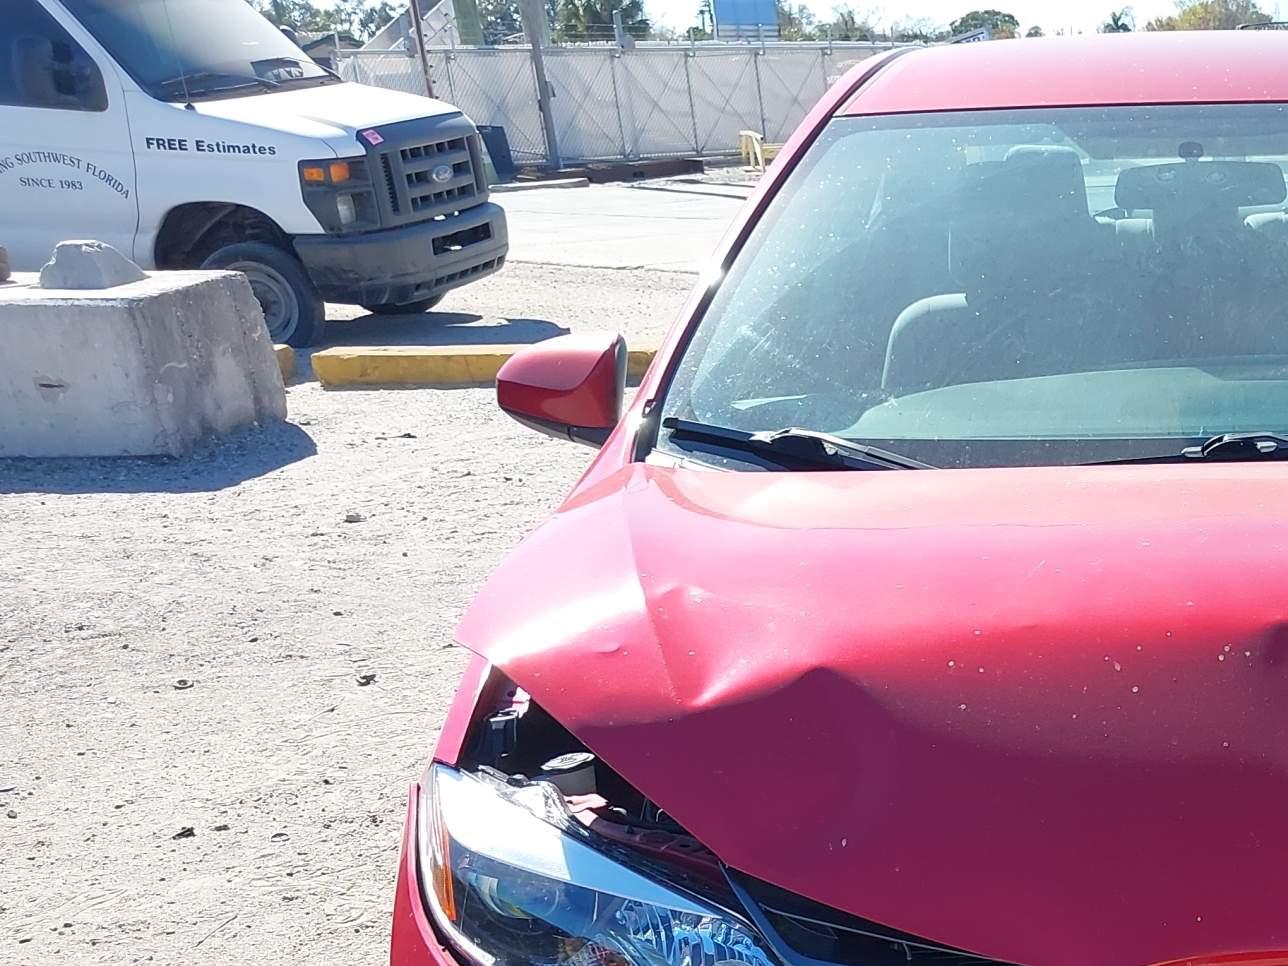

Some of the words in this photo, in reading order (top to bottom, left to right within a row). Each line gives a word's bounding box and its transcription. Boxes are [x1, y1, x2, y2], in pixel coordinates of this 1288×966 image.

[145, 137, 188, 151] FREE
[195, 139, 277, 156] Estimates
[15, 151, 82, 170] SOUTHWEST
[86, 163, 130, 199] FLORIDA
[19, 176, 55, 189] SINCE
[59, 179, 84, 191] 1983
